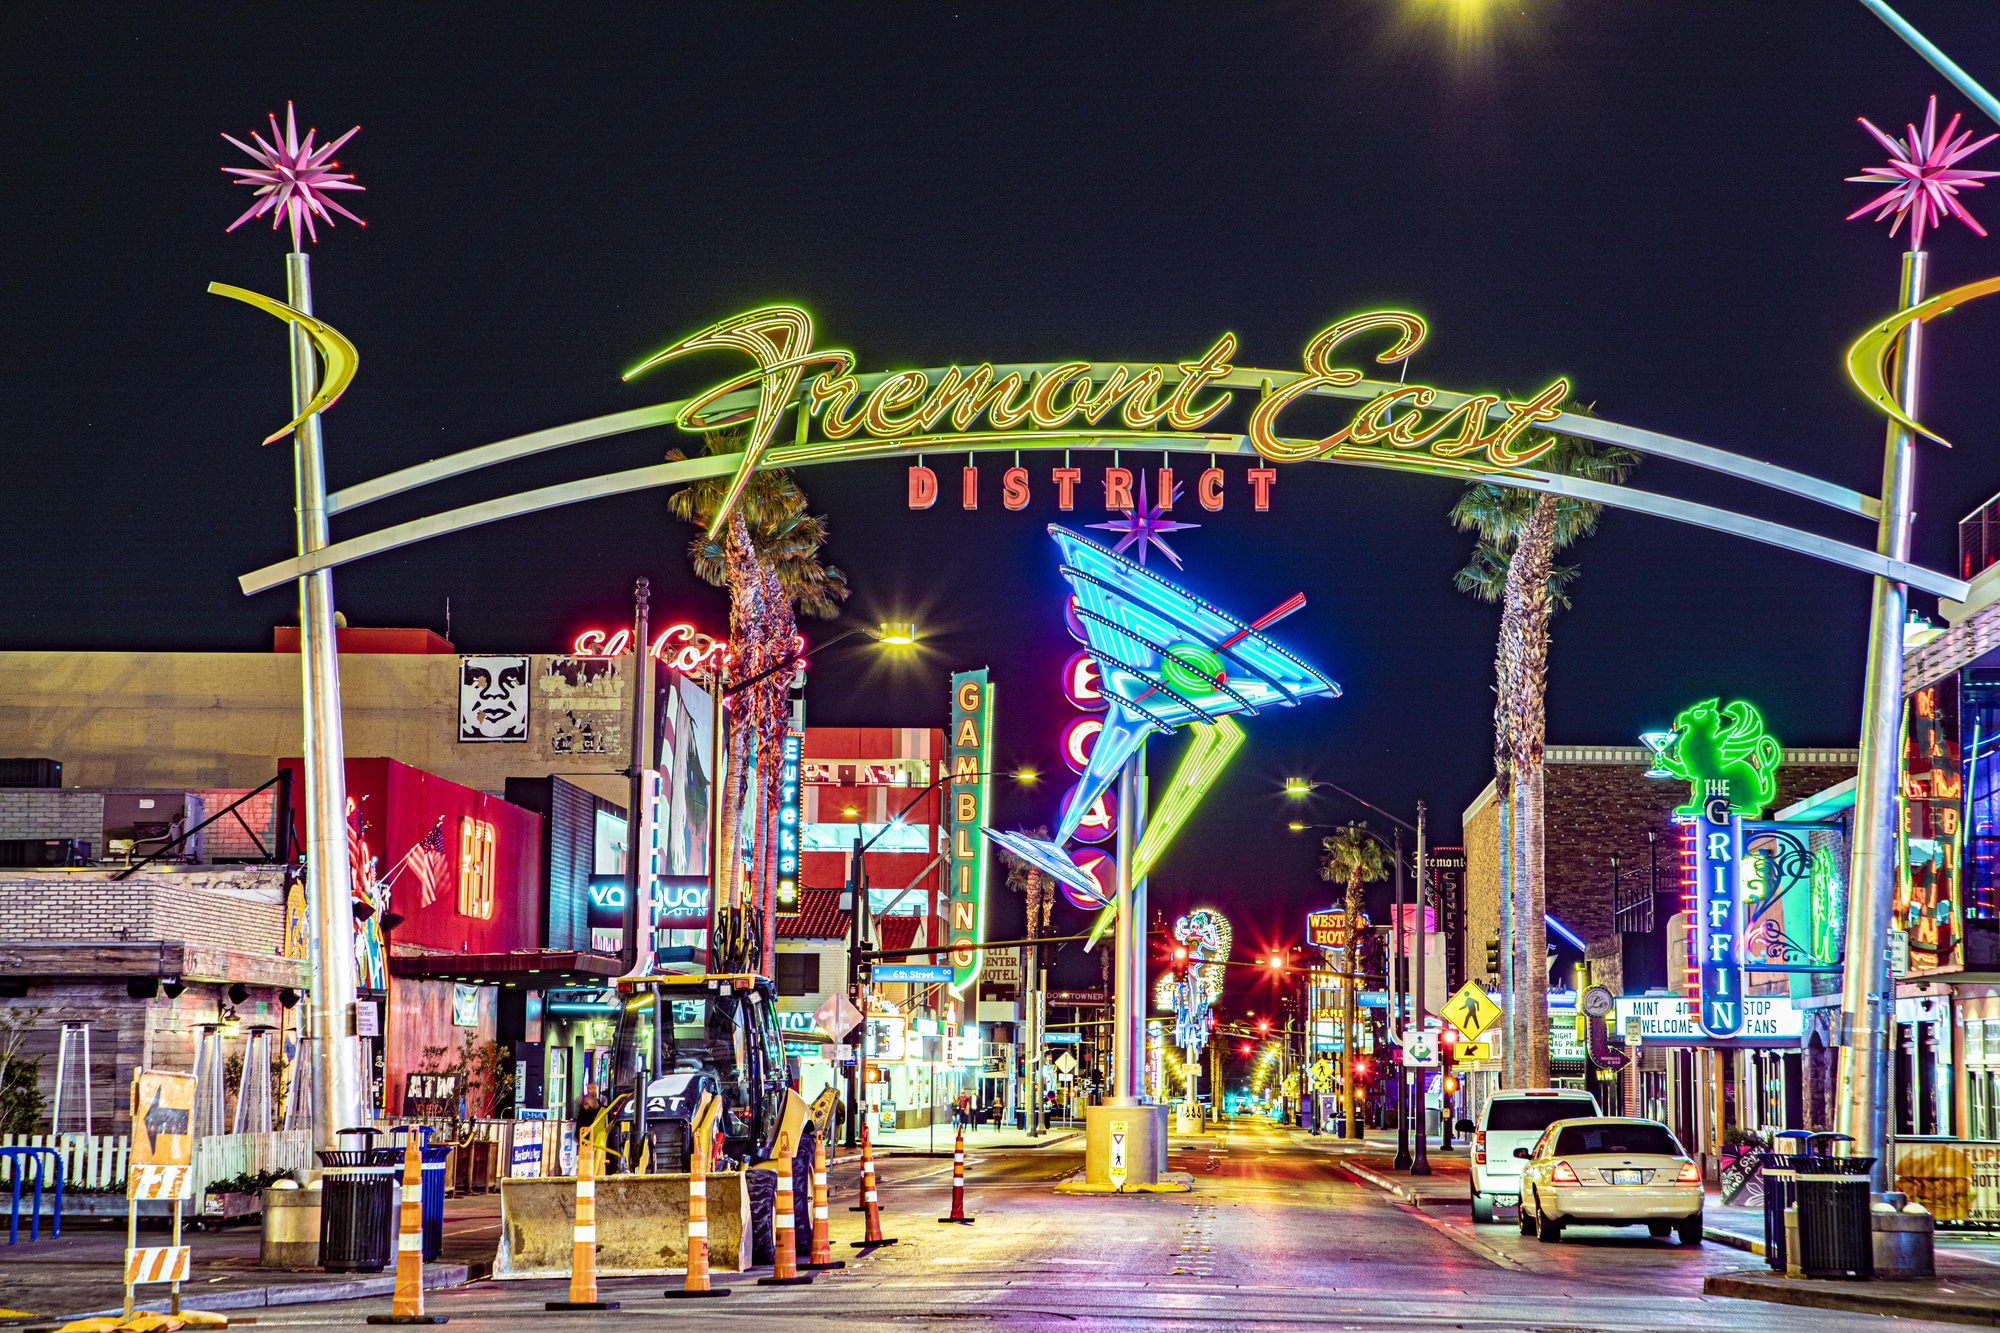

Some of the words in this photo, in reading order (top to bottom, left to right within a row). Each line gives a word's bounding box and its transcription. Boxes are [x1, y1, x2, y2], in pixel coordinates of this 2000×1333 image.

[622, 303, 1237, 540] Fremont
[1250, 309, 1570, 466] East
[908, 465, 1276, 511] DISTRICT
[1704, 779, 1730, 797] THE
[780, 739, 798, 873] Eureka
[952, 682, 981, 967] GAMBLING
[459, 815, 497, 921] RED
[1310, 914, 1366, 928] WESTN
[1705, 799, 1735, 1029] GRIFFIN
[988, 946, 1009, 956] CITY
[984, 957, 1017, 967] ENTER
[893, 969, 908, 979] 6th
[910, 970, 935, 979] Street
[980, 969, 1018, 981] MOTEL
[1633, 1002, 1659, 1015] MINT
[1744, 1001, 1771, 1015] STOP
[1642, 1019, 1693, 1034] WELCOME
[1747, 1020, 1777, 1034] FANS
[407, 1075, 456, 1099] ATM
[624, 1096, 686, 1114] CAT
